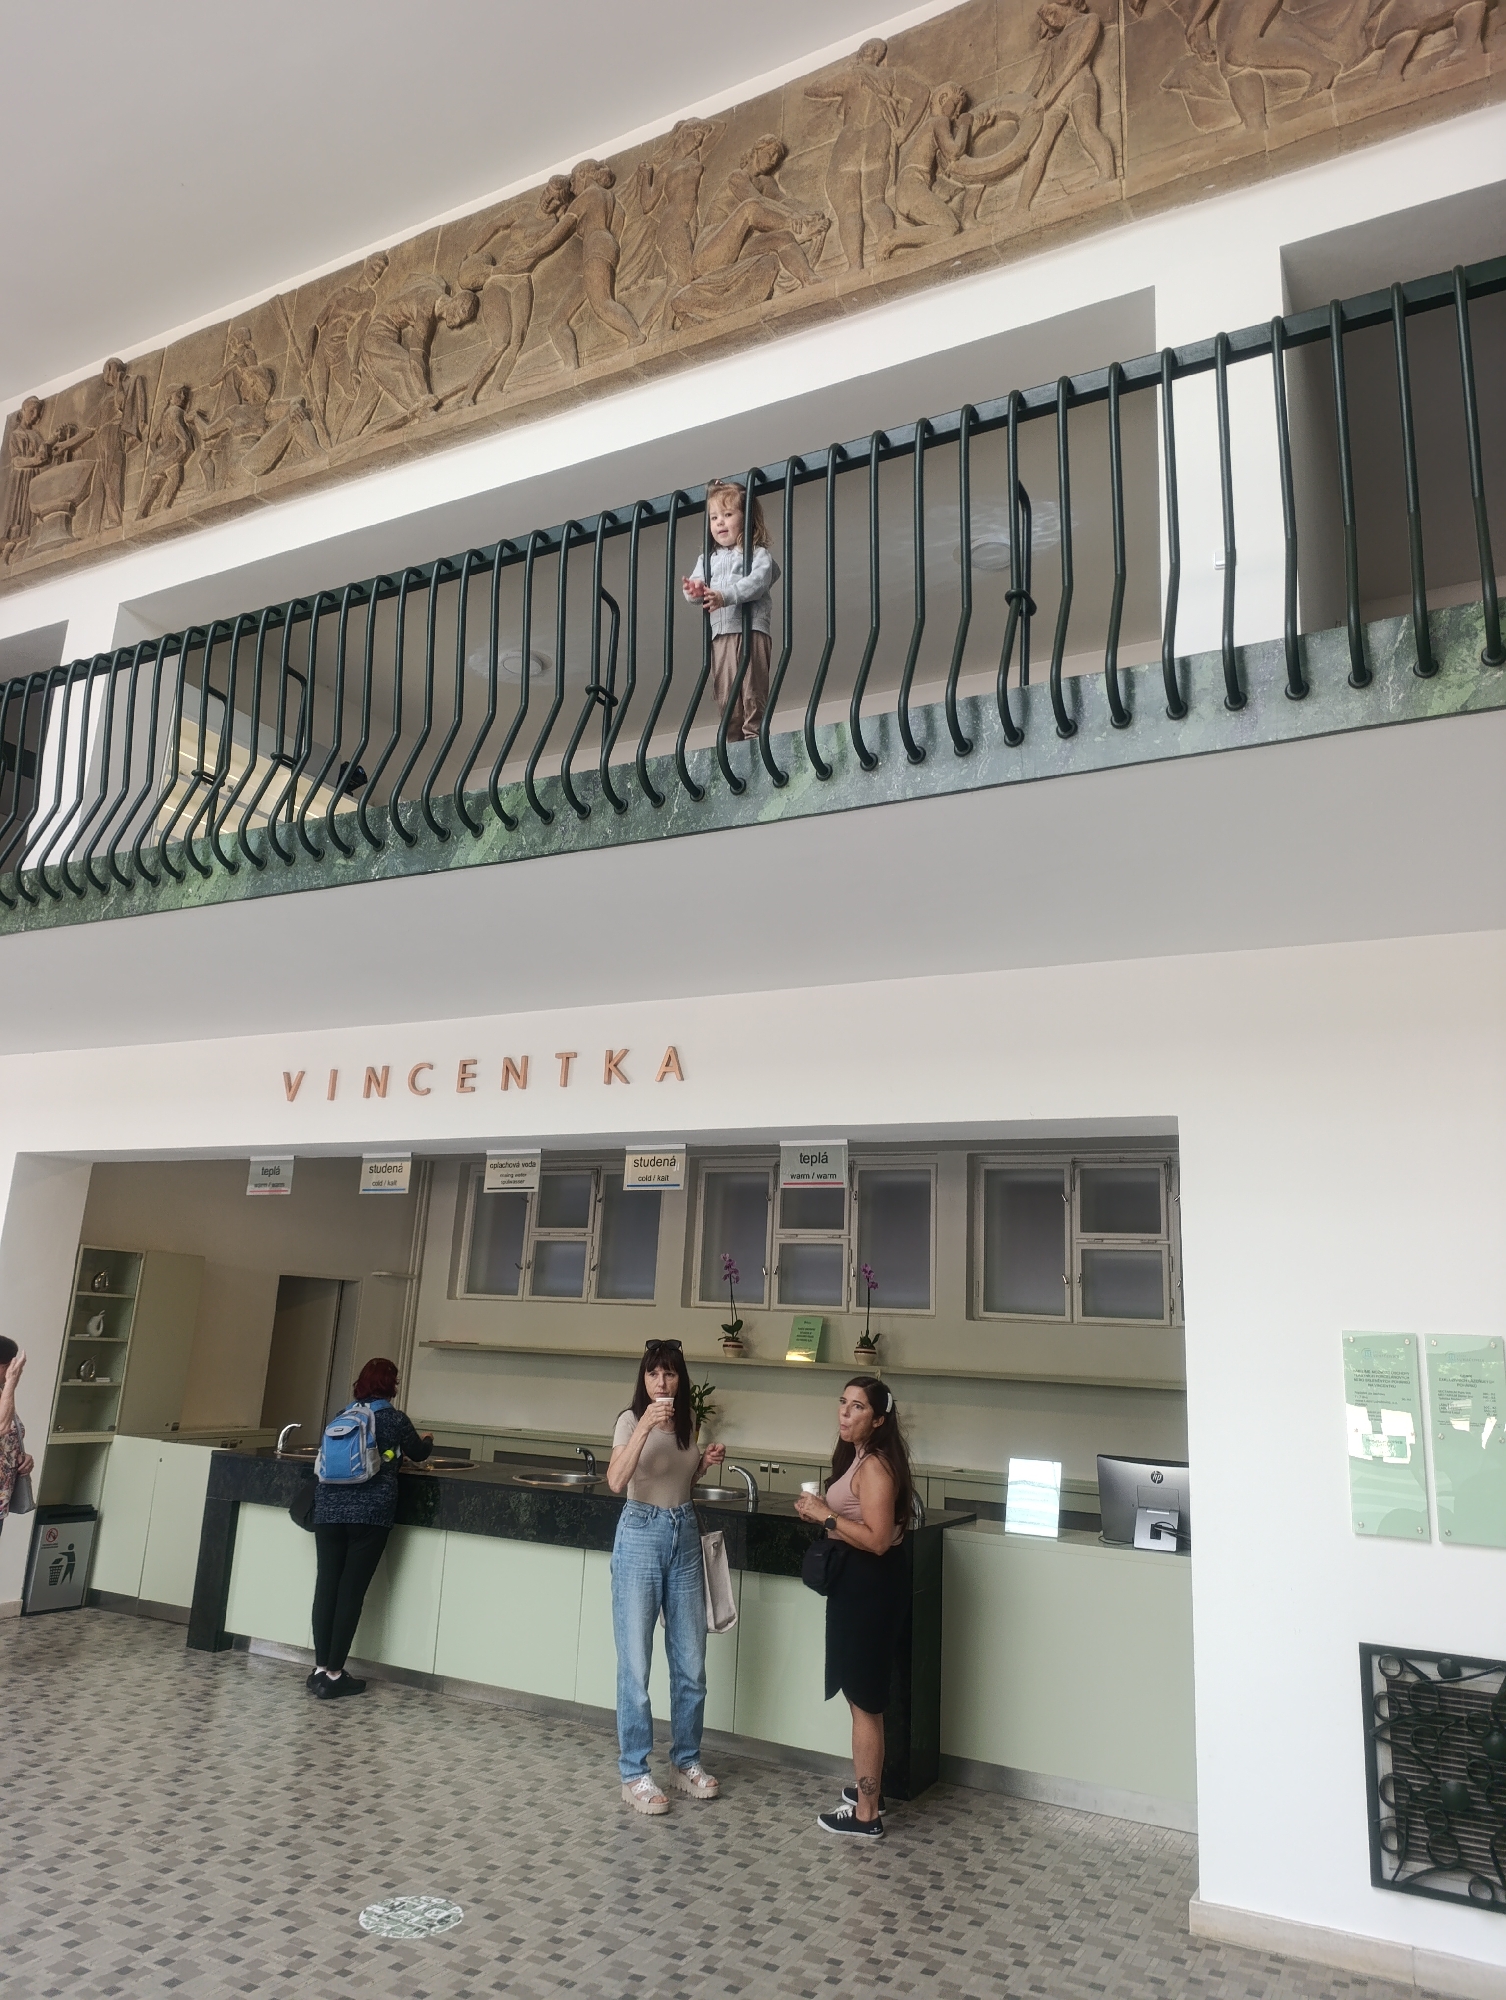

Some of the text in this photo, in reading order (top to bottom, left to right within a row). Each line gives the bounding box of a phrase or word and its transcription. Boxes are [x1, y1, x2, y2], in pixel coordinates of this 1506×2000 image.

[283, 1046, 685, 1102] VINCENTKA
[633, 1155, 676, 1168] studená
[799, 1151, 829, 1167] teplá
[261, 1165, 281, 1178] teplá
[368, 1162, 404, 1174] studená
[1151, 1470, 1164, 1484] hp
